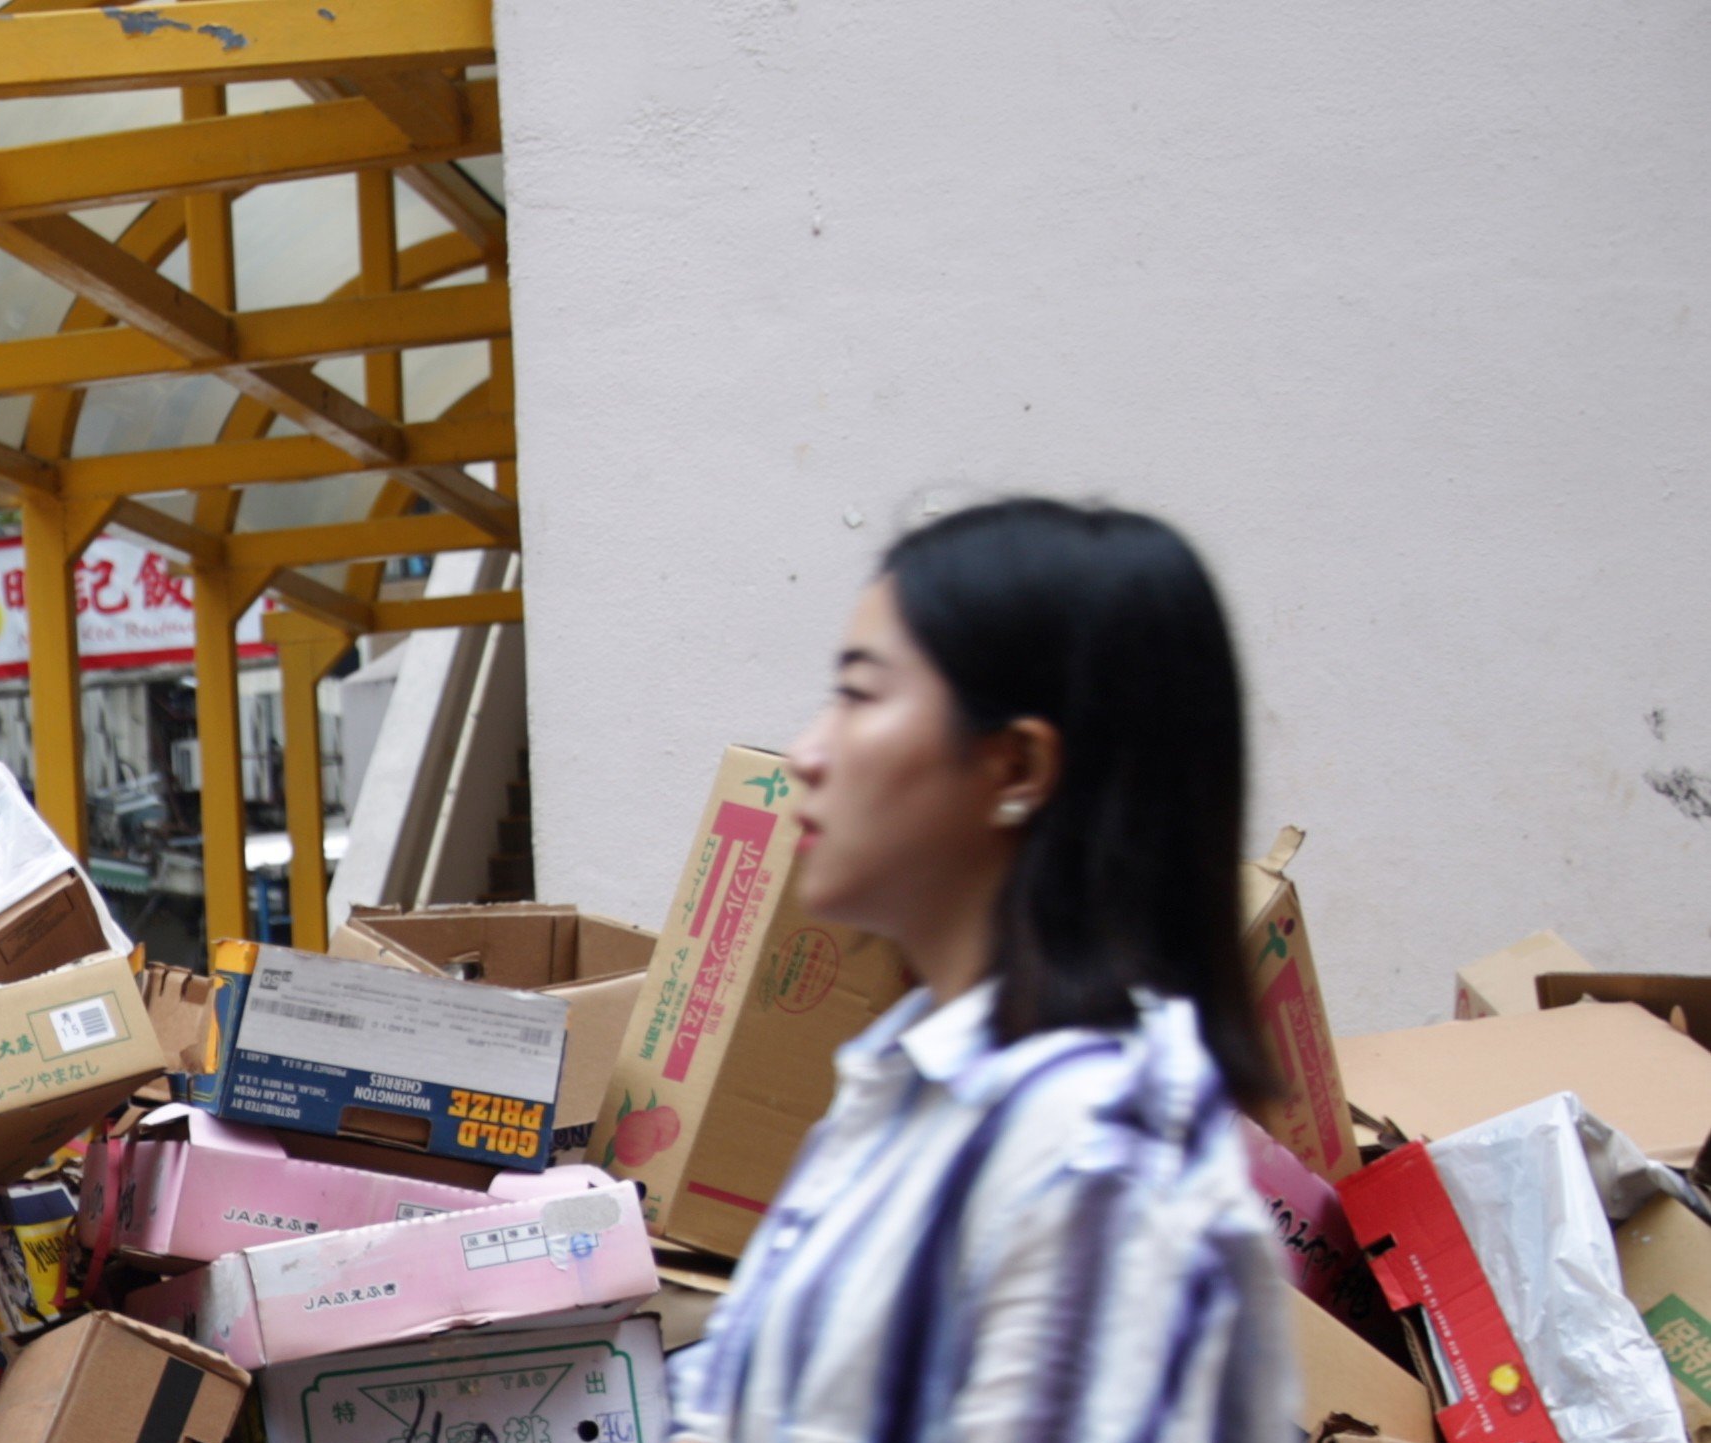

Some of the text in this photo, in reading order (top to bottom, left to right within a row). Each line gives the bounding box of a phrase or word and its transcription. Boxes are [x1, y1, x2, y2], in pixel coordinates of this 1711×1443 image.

[676, 838, 763, 1050] JAフルーツやまなし
[353, 1085, 432, 1112] WASHINGTON
[369, 1072, 424, 1095] CHERRIES
[447, 1088, 545, 1131] PRIZE
[457, 1119, 541, 1159] GOLD
[499, 1371, 550, 1390] TAO
